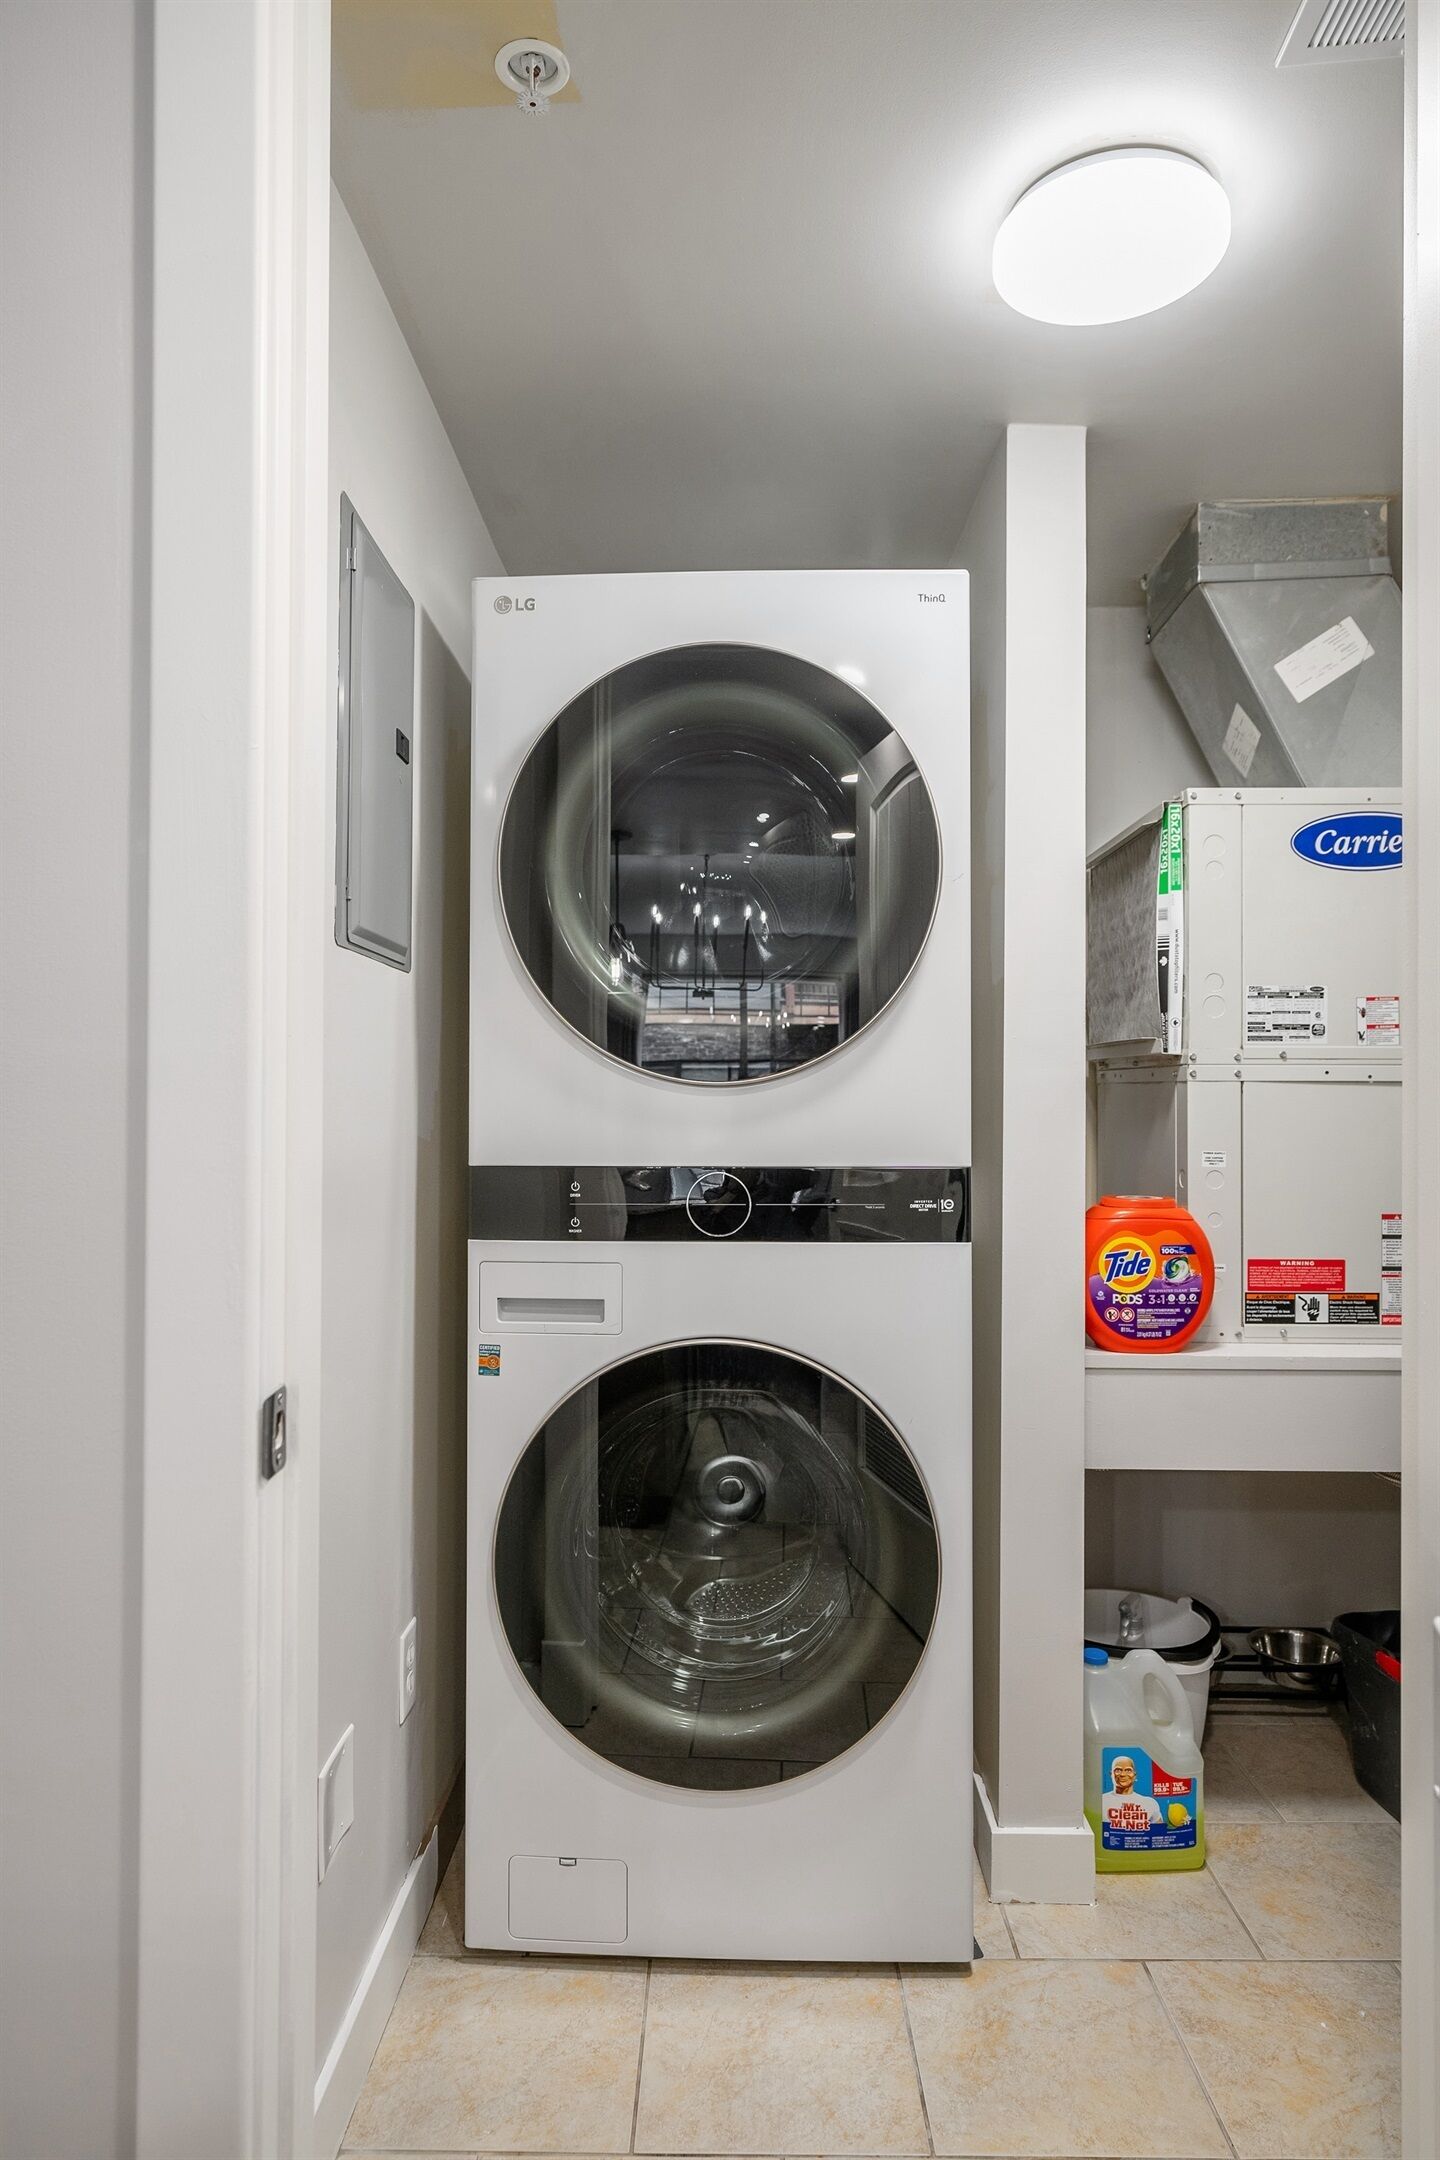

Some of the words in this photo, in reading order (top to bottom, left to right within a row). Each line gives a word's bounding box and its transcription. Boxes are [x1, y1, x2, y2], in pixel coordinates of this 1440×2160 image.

[917, 593, 947, 603] ThinQ
[515, 598, 536, 611] LG
[1169, 806, 1181, 853] 16x20x1
[1314, 829, 1402, 855] Carrie
[1104, 1249, 1152, 1284] Tide
[1112, 1294, 1143, 1304] PODS
[1122, 1803, 1144, 1812] Mr.
[1108, 1808, 1148, 1820] Clean
